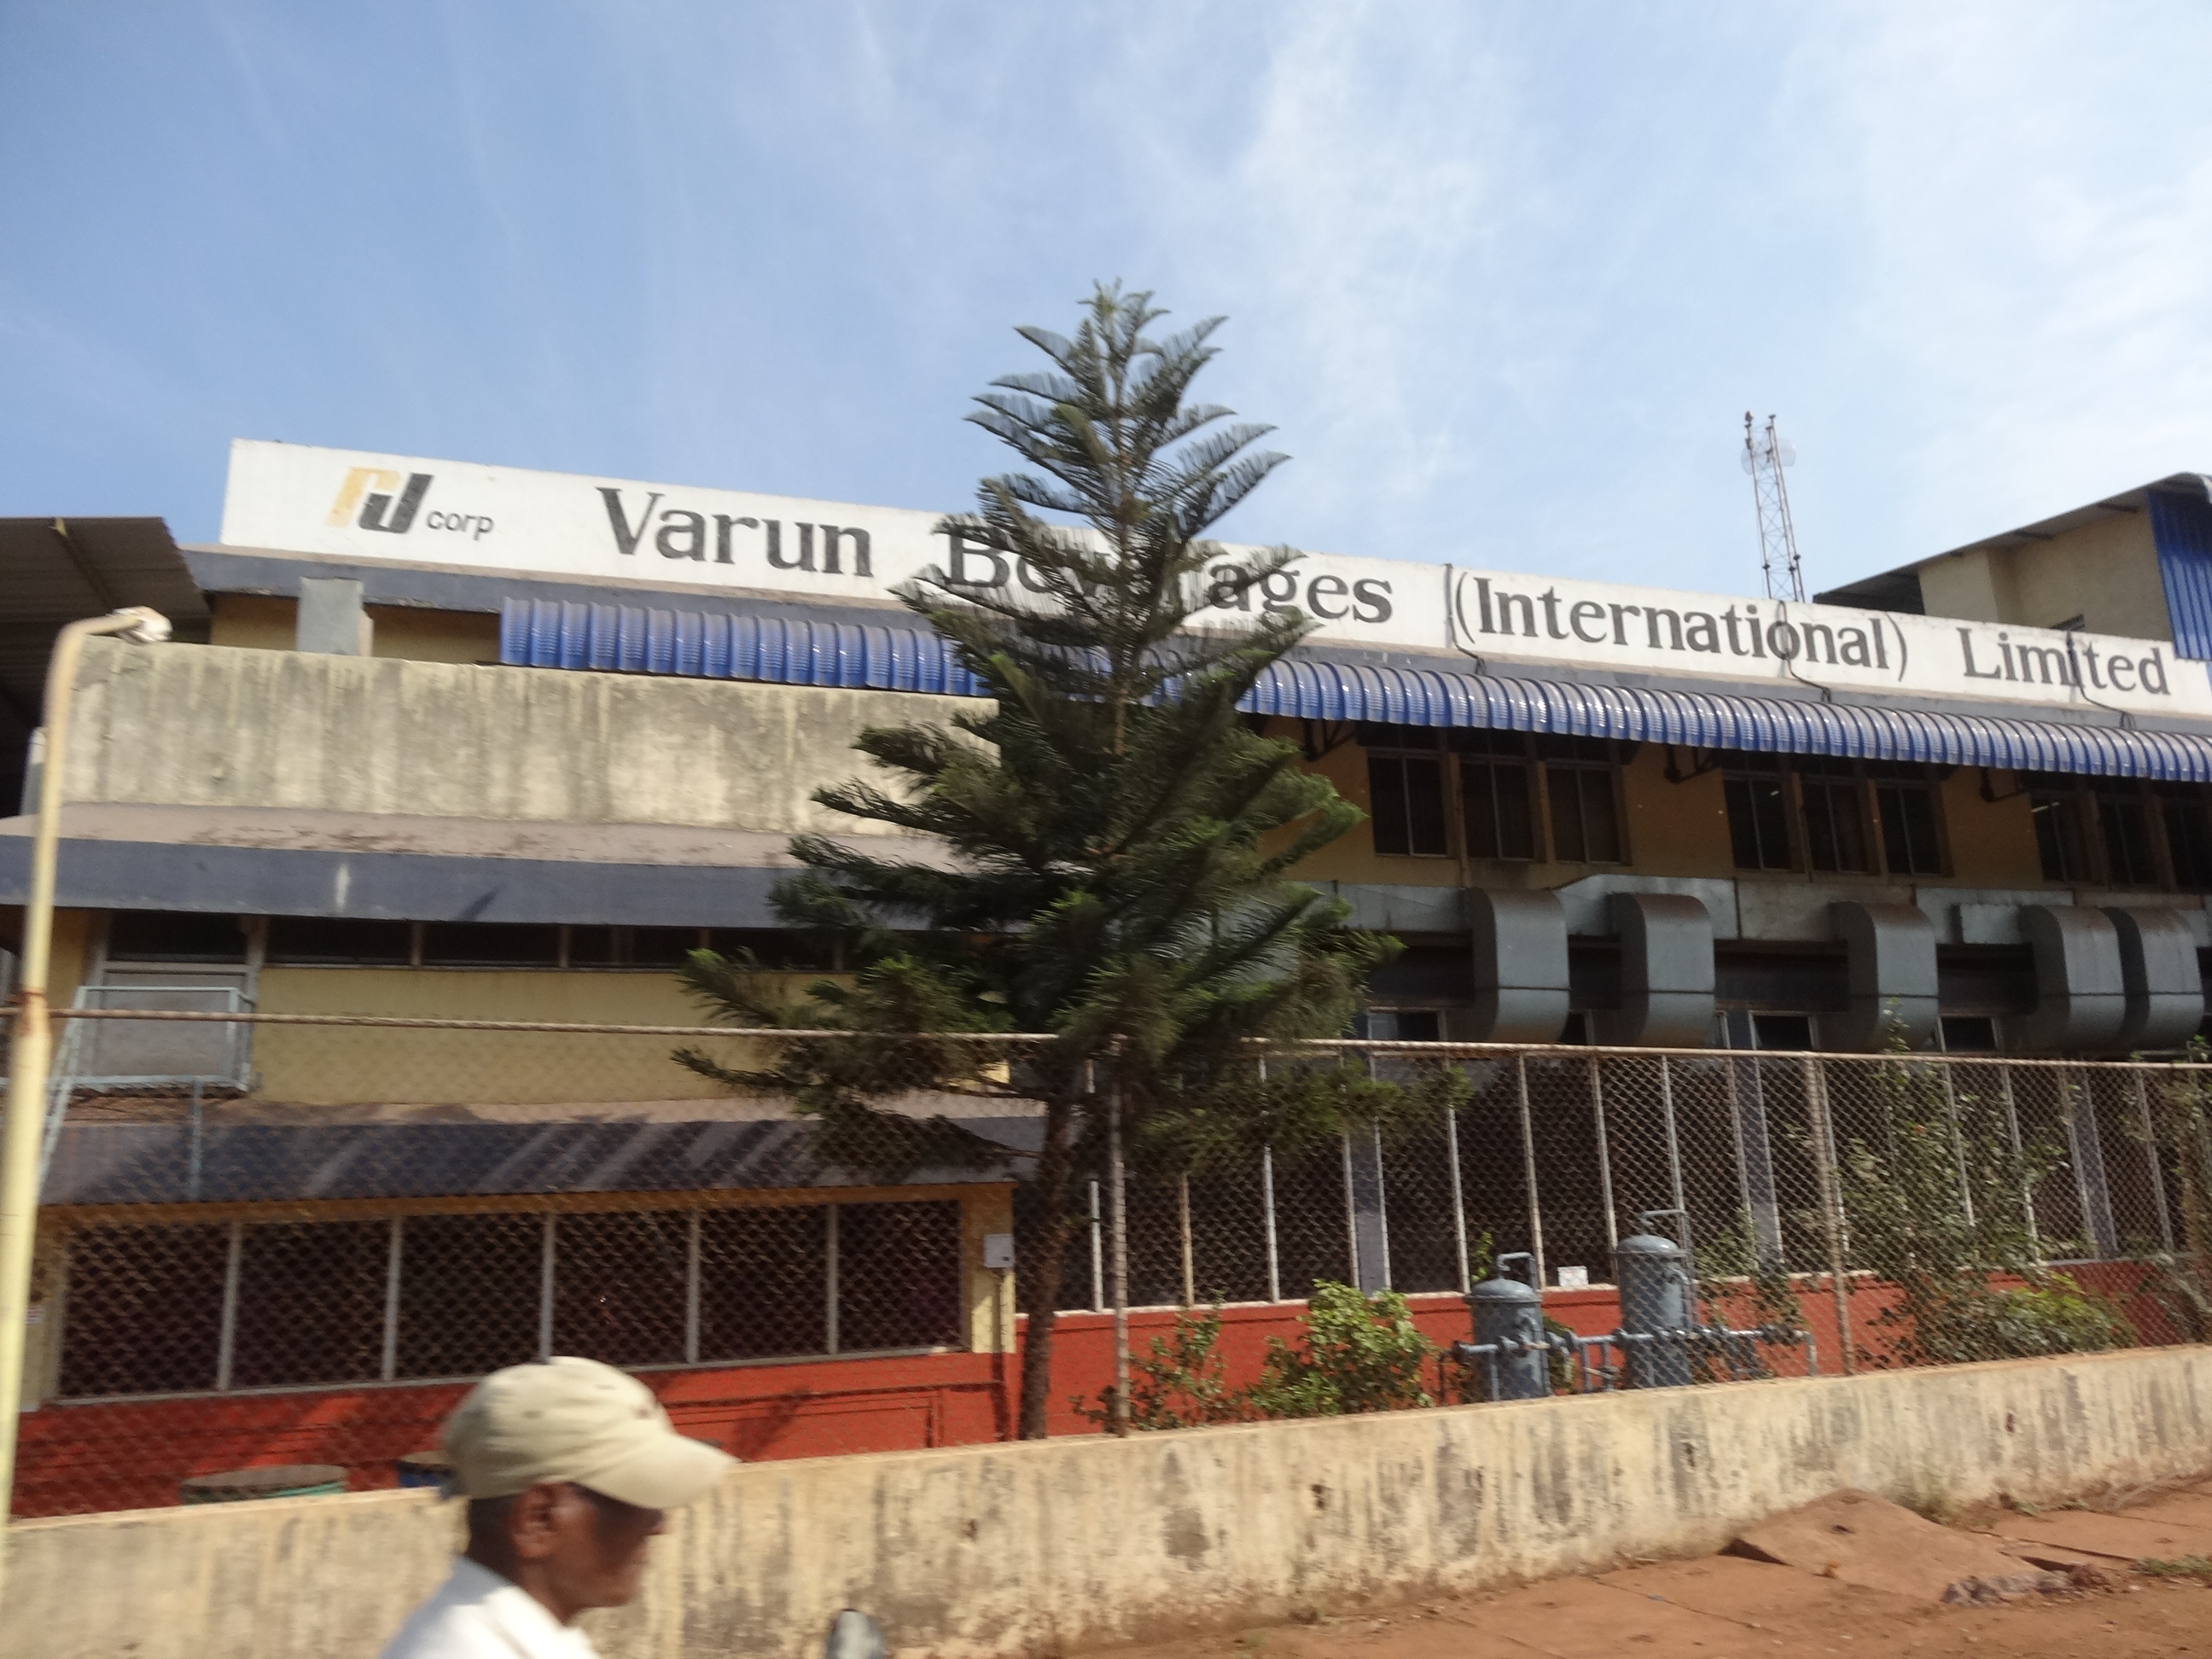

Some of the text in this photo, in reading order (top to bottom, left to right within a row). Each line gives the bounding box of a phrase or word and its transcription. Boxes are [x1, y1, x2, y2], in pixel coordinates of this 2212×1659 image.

[427, 510, 494, 541] corp
[595, 486, 2171, 696] Varun Bages (International) Limited
